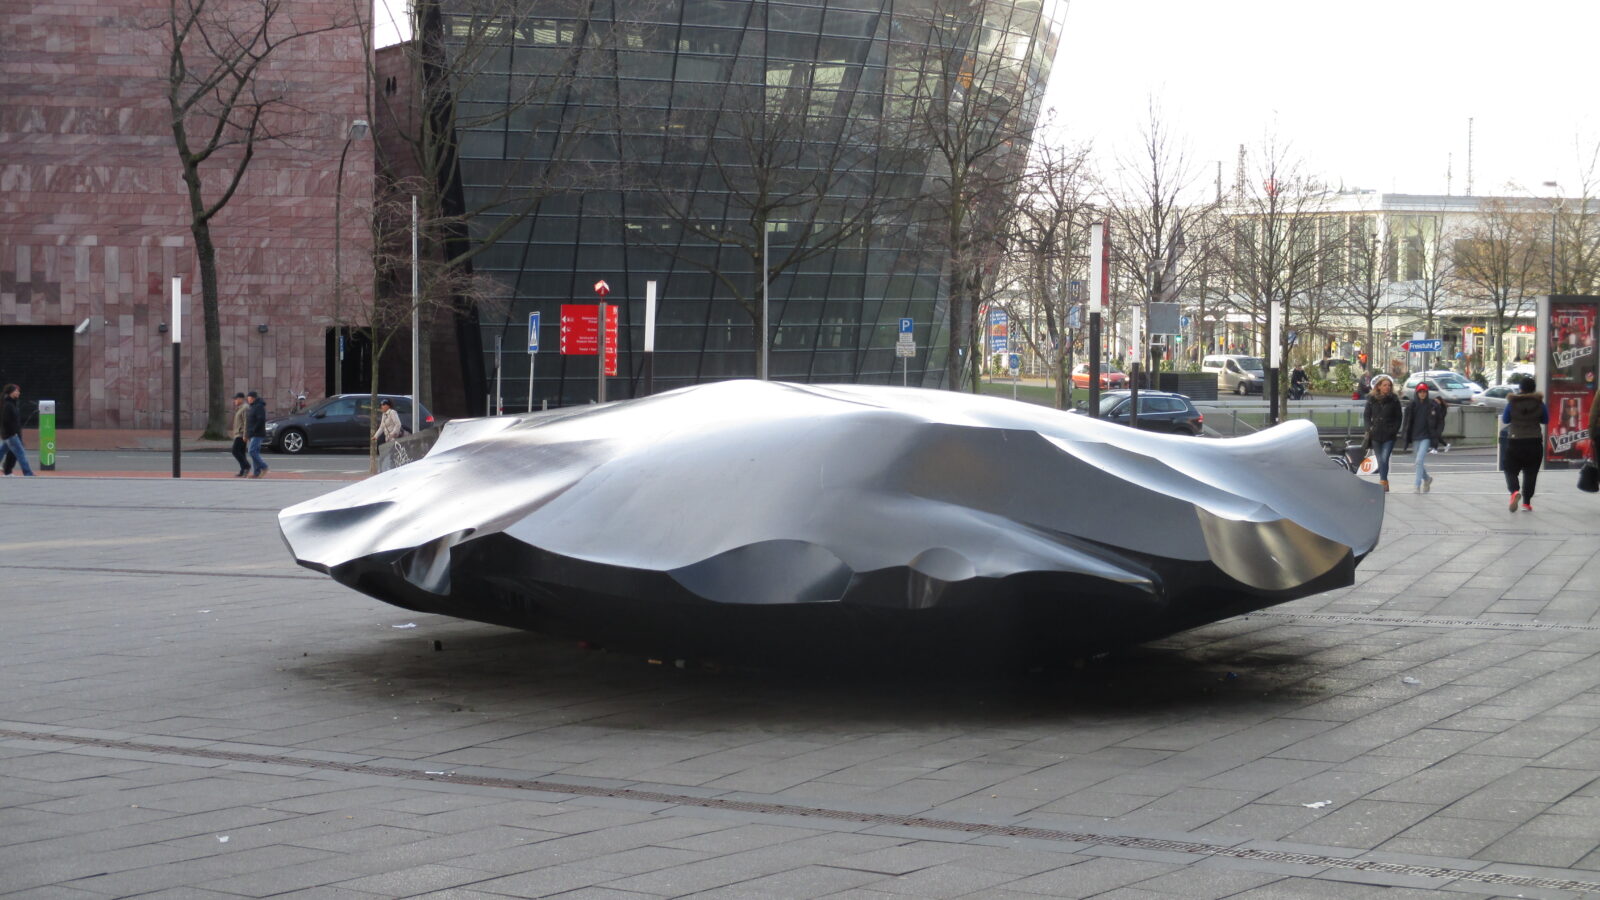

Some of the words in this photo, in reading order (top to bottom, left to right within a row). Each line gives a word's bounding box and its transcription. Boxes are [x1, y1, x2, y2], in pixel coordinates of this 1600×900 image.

[902, 319, 910, 331] P
[1434, 341, 1440, 349] P
[1552, 346, 1592, 368] Voice
[1549, 430, 1589, 453] Voice
